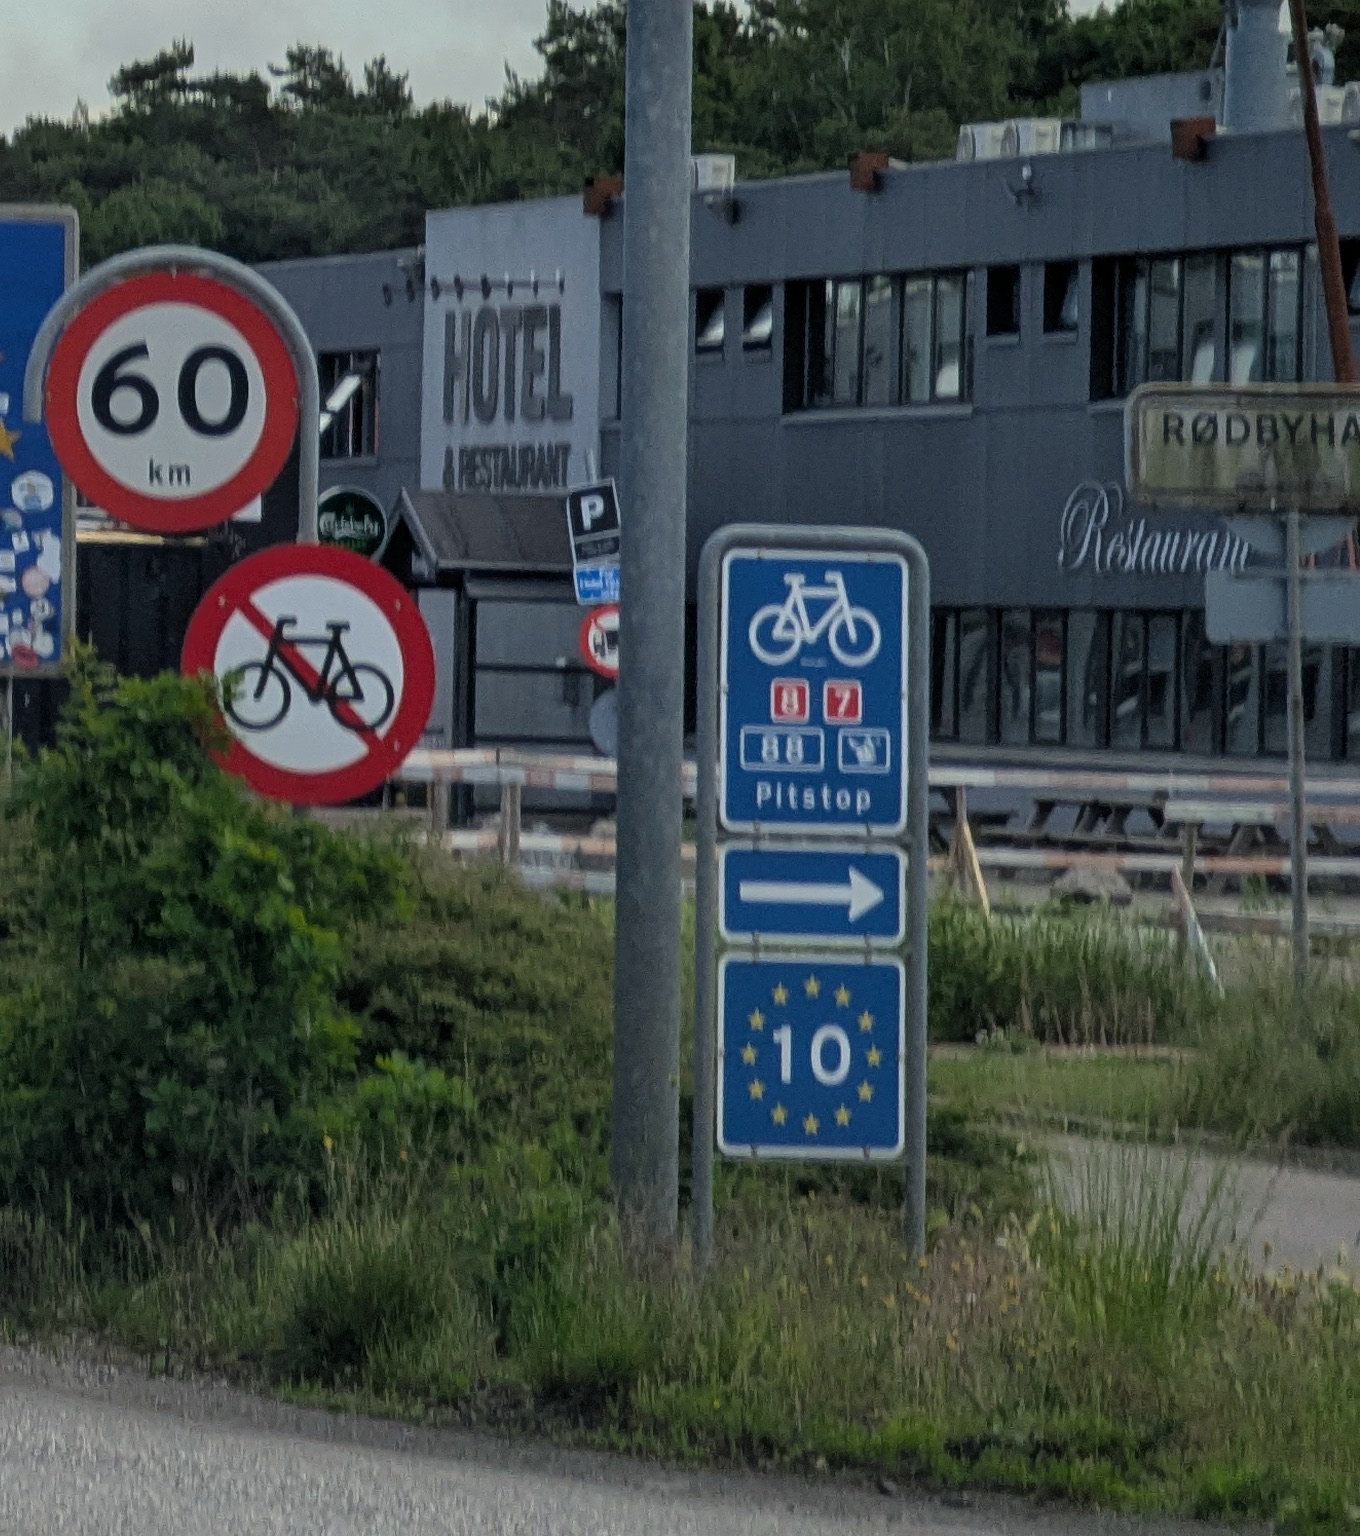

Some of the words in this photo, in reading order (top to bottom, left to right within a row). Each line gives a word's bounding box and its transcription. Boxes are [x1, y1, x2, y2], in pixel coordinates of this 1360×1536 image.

[443, 303, 573, 426] HOTEL
[91, 340, 250, 438] 60
[147, 458, 192, 486] km
[458, 442, 572, 492] RESTAURANT
[580, 494, 605, 532] P
[835, 686, 852, 717] 7
[756, 781, 872, 816] Pitstop
[772, 1024, 852, 1087] 10
